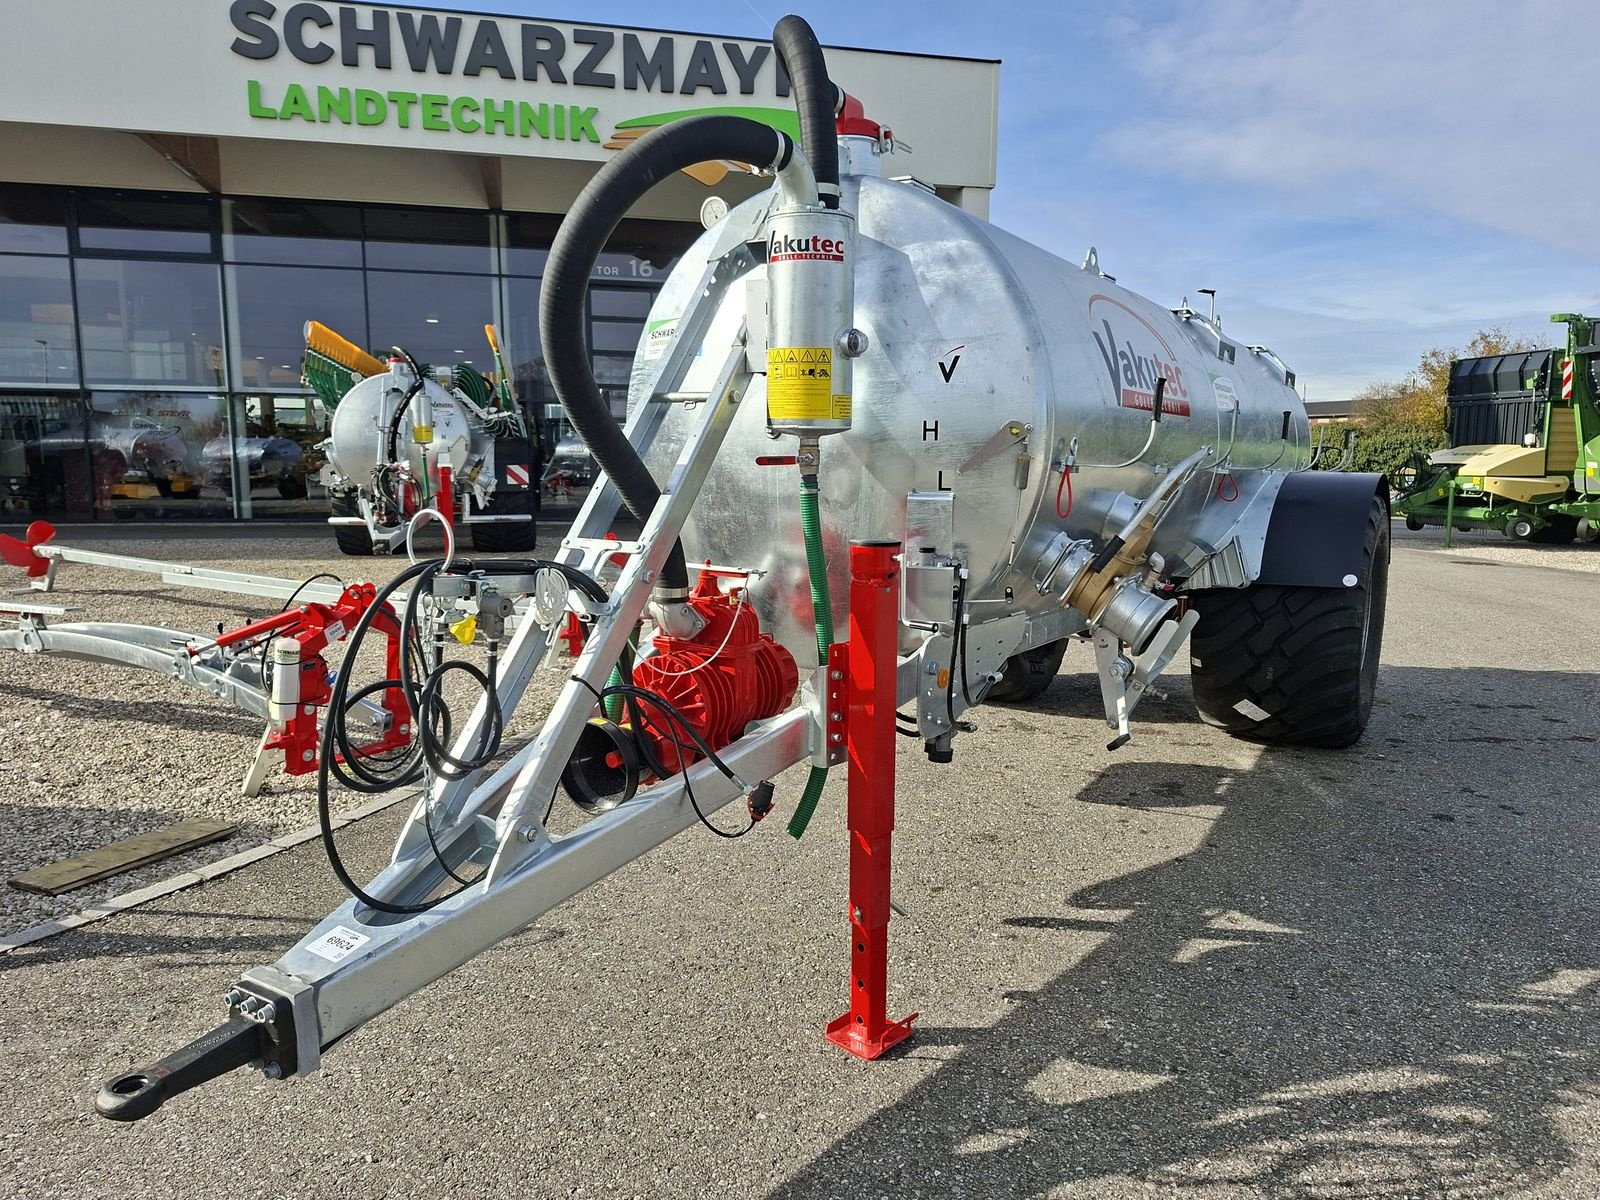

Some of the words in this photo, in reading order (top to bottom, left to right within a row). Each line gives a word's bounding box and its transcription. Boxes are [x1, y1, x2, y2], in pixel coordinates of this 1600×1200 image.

[229, 0, 791, 98] SCHWARZMAY
[246, 79, 600, 143] LANDTECHNIK
[768, 230, 844, 264] Vakutec
[596, 265, 620, 276] TOR
[629, 259, 653, 277] 16
[937, 355, 961, 384] V
[1092, 318, 1188, 407] Vakutec
[922, 419, 939, 442] H
[937, 470, 952, 492] L
[326, 935, 355, 951] 69624
